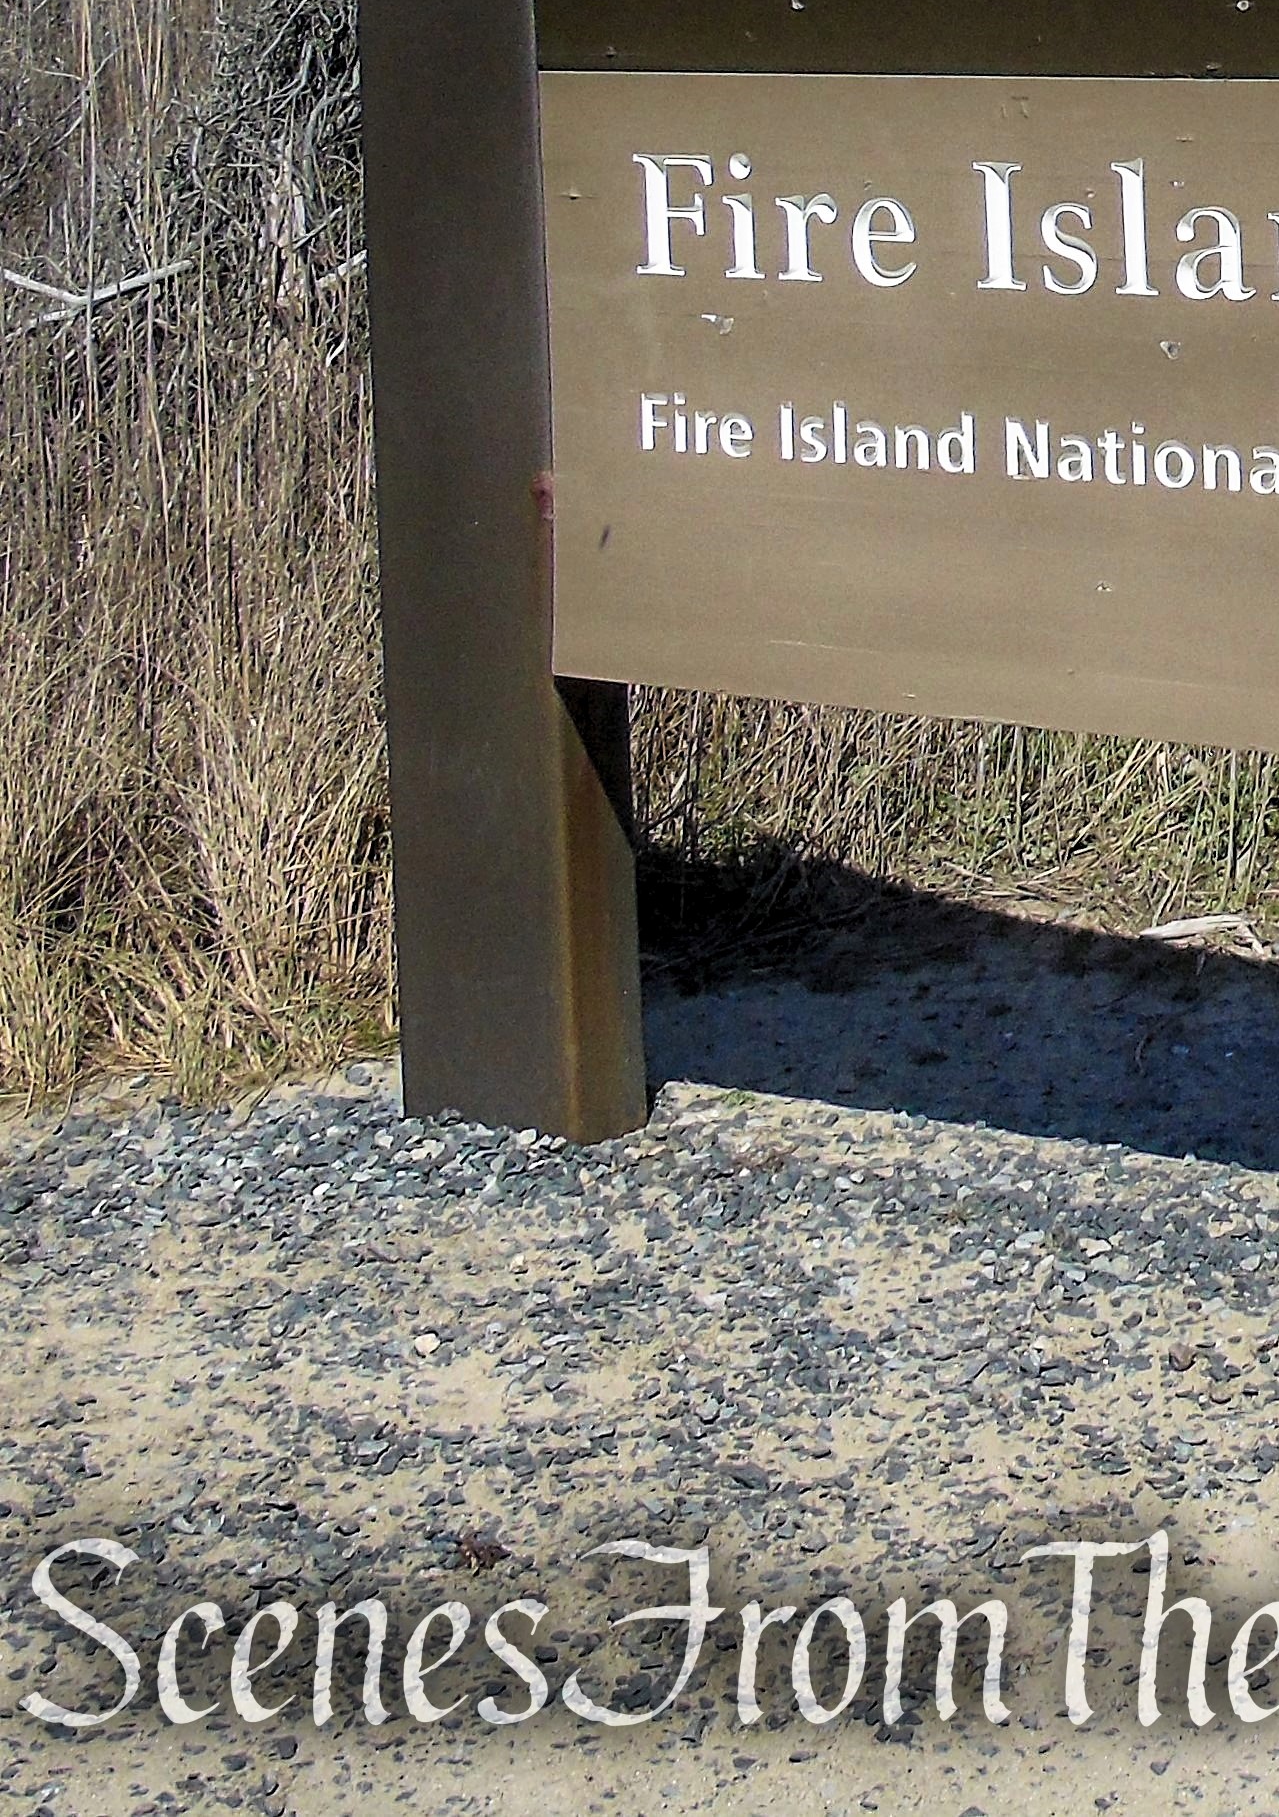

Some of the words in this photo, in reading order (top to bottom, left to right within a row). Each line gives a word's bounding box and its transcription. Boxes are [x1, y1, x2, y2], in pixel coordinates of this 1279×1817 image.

[632, 152, 918, 287] Fire
[638, 393, 755, 459] Fire
[777, 401, 978, 474] Island
